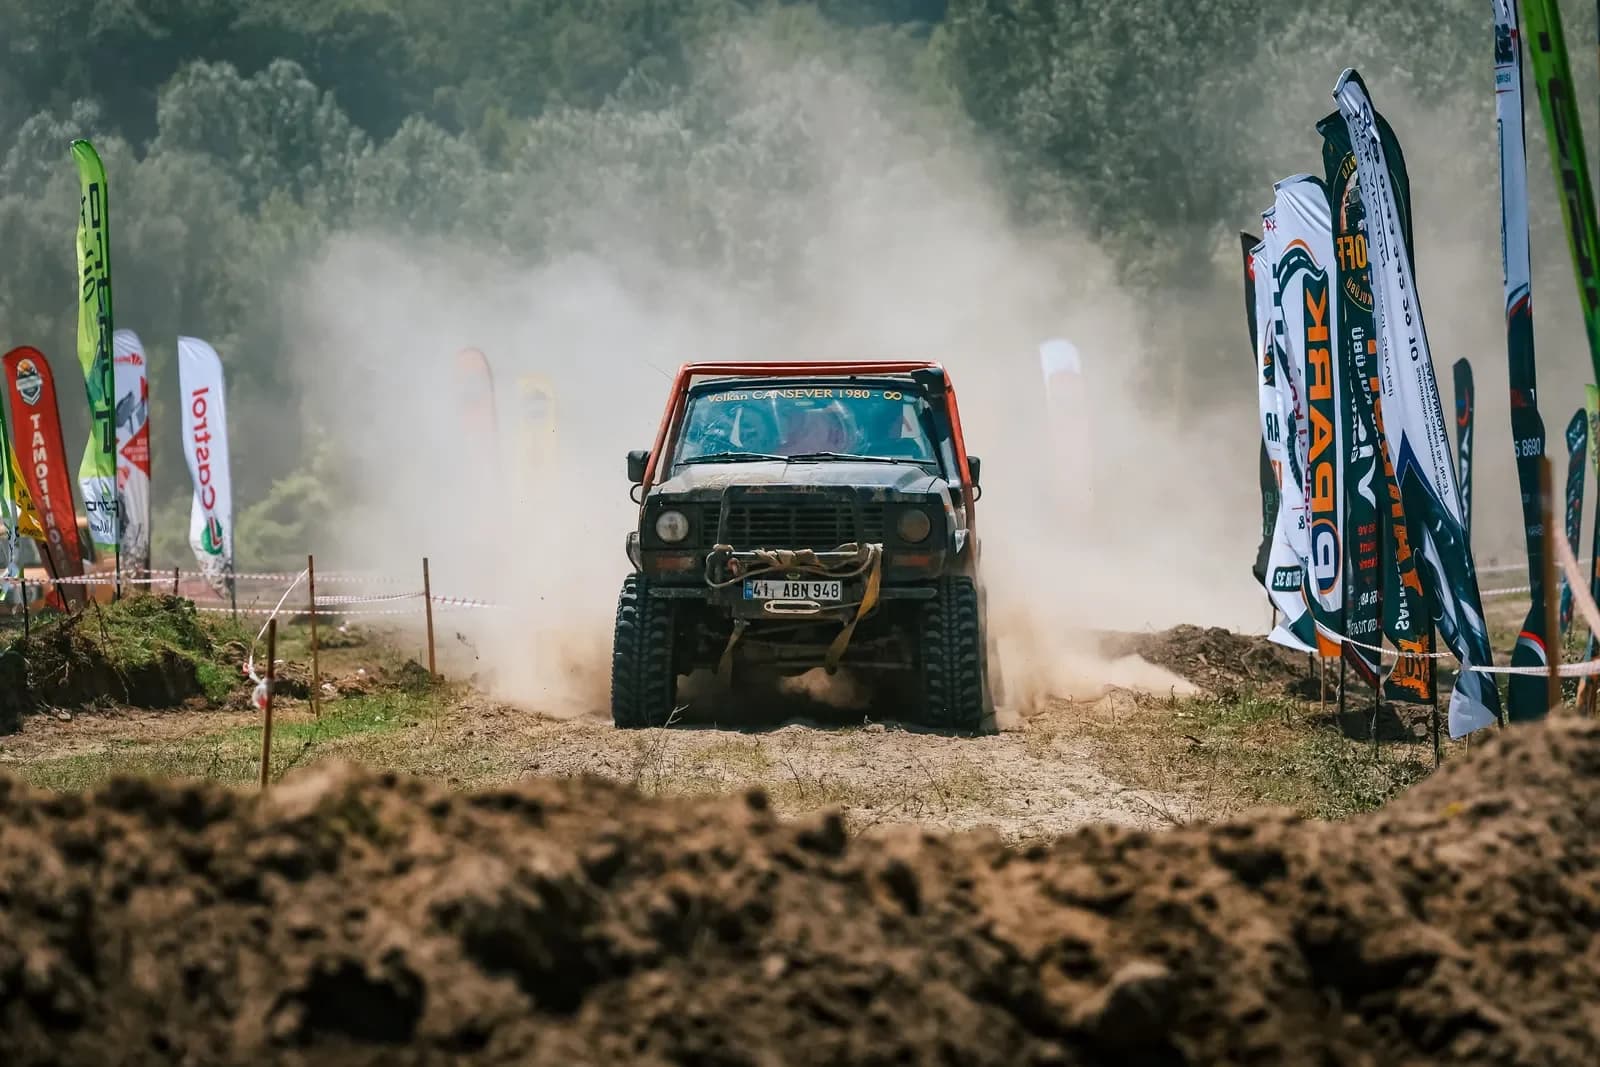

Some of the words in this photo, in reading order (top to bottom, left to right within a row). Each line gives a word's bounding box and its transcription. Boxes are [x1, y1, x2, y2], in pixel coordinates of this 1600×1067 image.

[752, 389, 833, 400] CANSEVER
[839, 390, 870, 399] 1980
[753, 582, 768, 597] 41
[783, 583, 809, 598] ABN
[813, 583, 839, 598] 948
